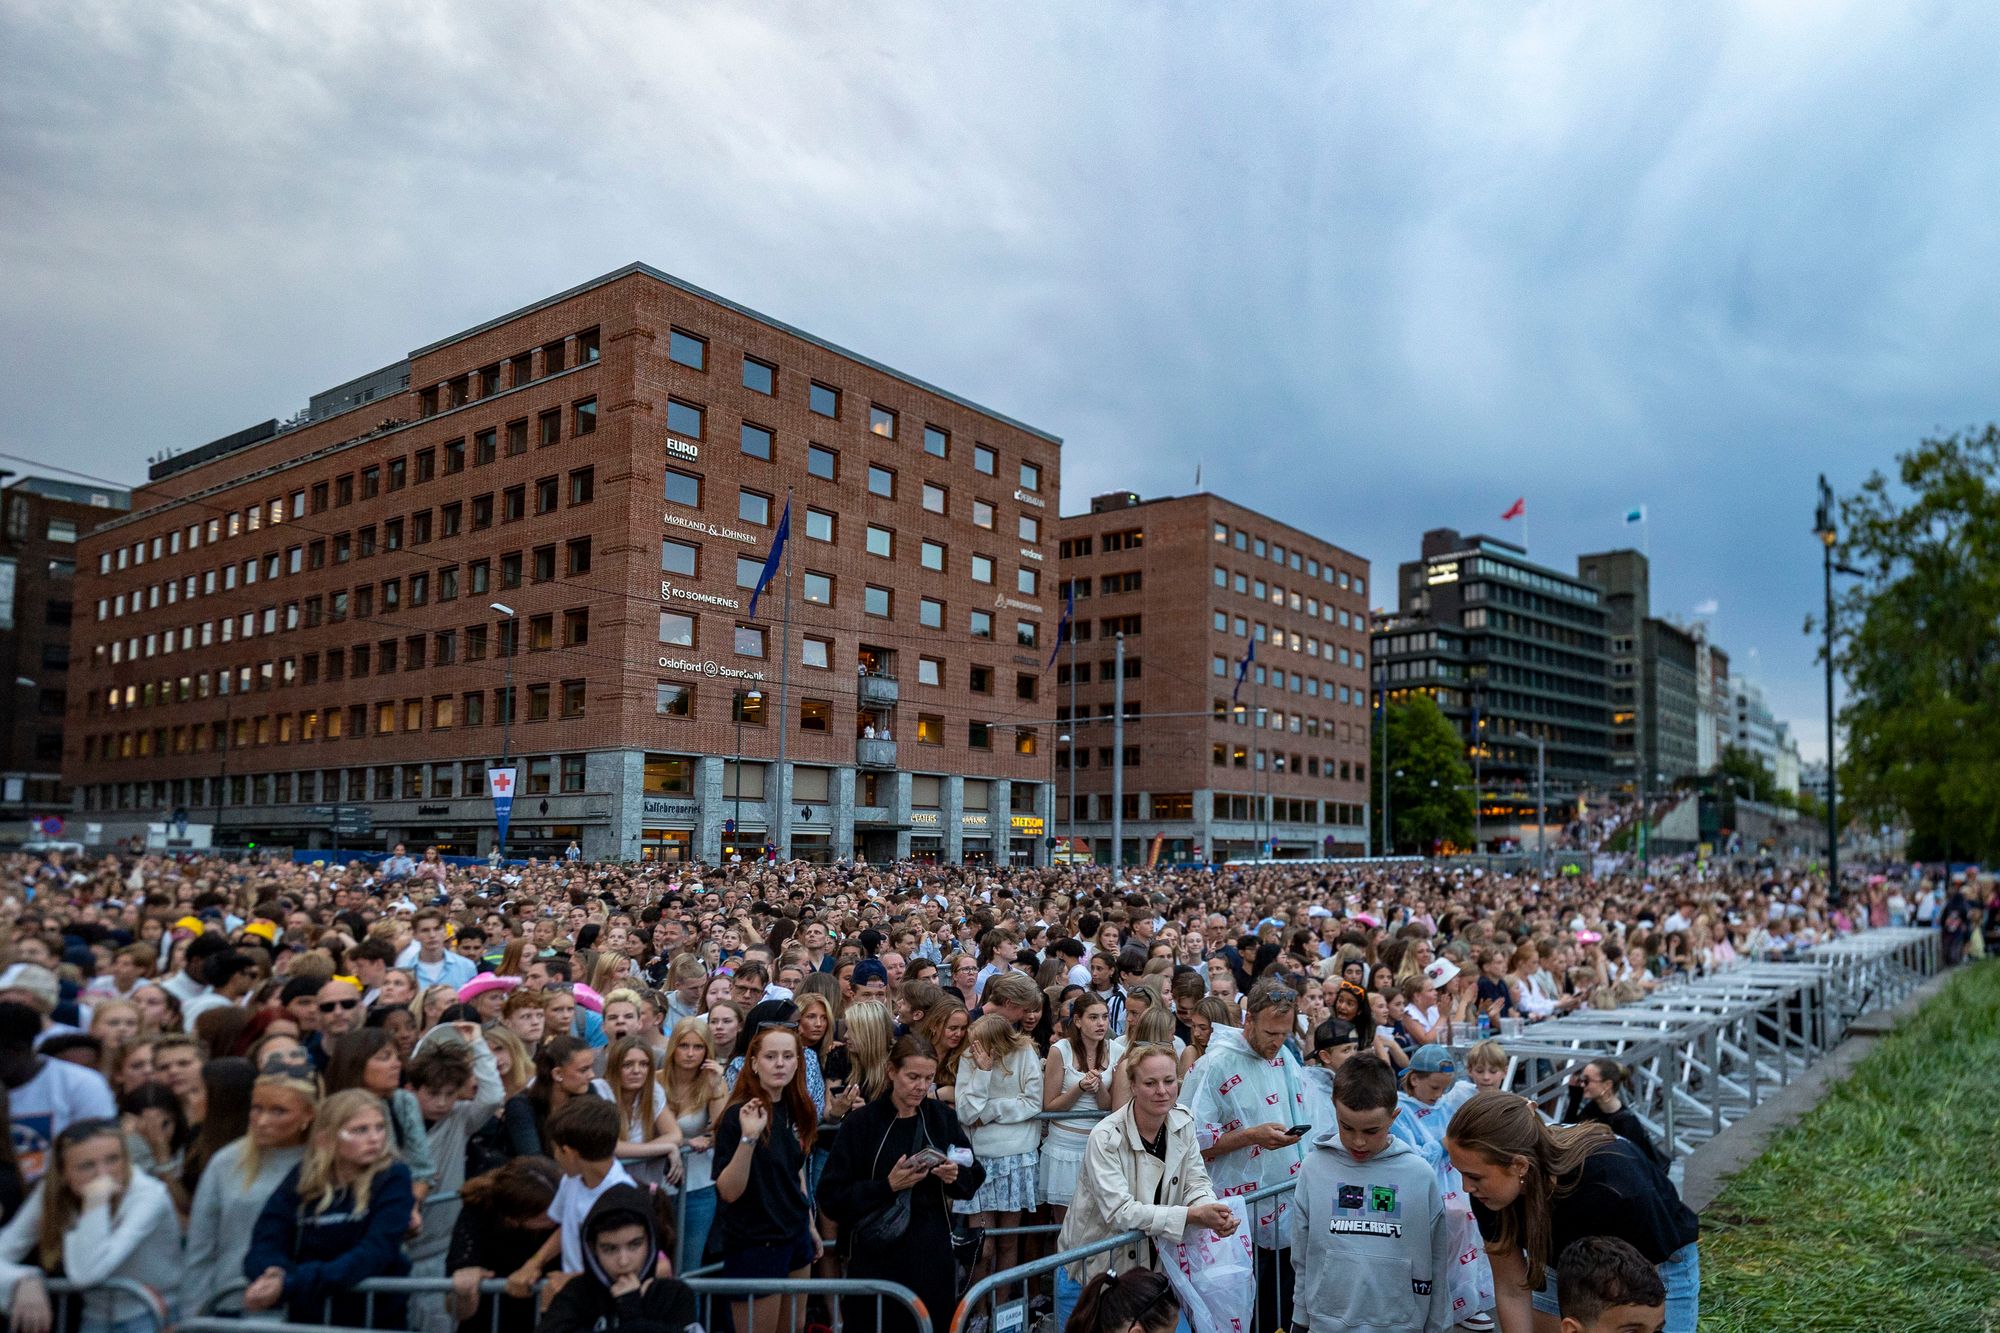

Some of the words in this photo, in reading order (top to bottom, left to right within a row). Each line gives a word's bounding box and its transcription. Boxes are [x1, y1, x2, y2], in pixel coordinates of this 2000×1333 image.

[667, 438, 698, 457] EURO
[664, 513, 706, 531] MØRLAND
[709, 525, 718, 536] &
[722, 527, 757, 544] JOHNSEN
[659, 657, 702, 672] Oslofjord
[1011, 816, 1044, 828] STETSON
[1219, 1074, 1242, 1095] VG
[1225, 1182, 1257, 1196] VG
[1329, 1218, 1403, 1238] MINECRAFT
